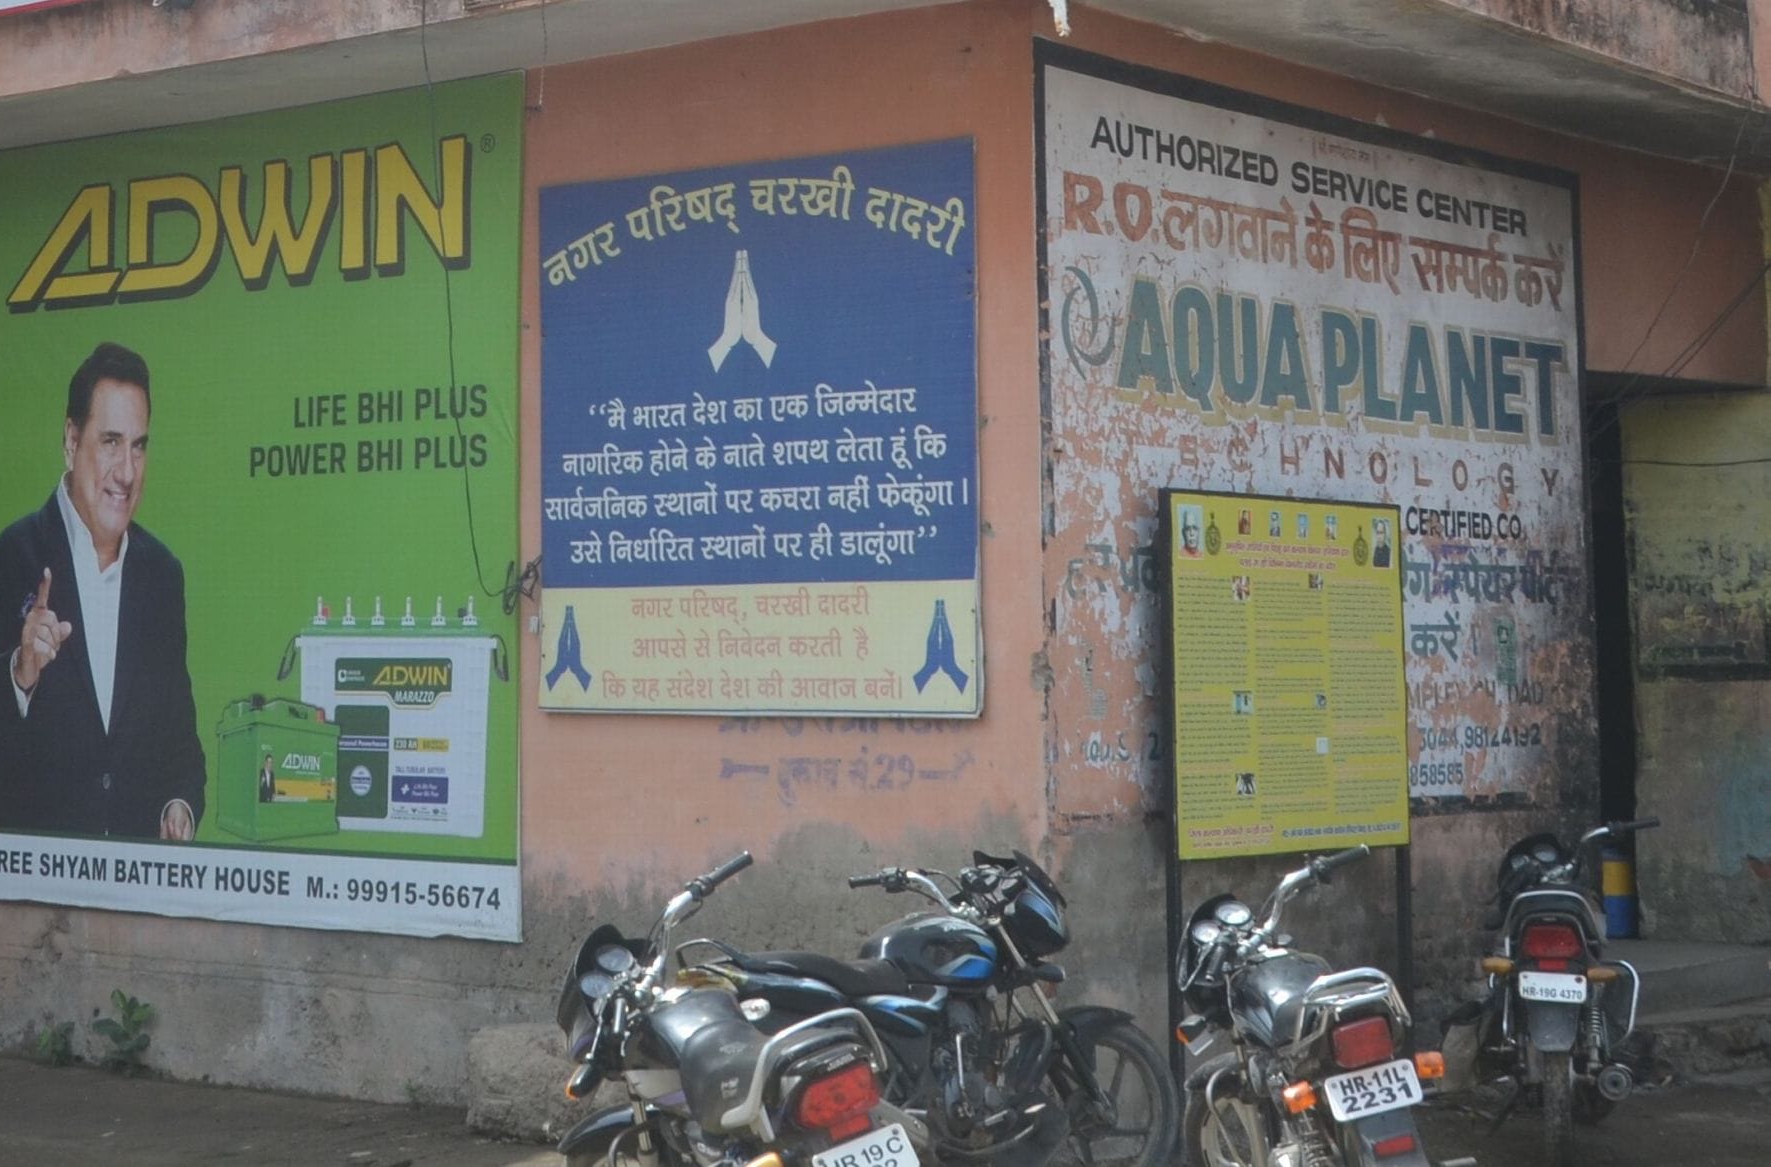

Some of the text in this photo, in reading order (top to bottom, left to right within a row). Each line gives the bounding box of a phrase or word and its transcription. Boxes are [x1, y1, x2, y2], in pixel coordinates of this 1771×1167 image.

[1091, 116, 1279, 187] AUTHORIZED
[1291, 162, 1407, 213] SERVICE
[1416, 189, 1527, 236] CENTER
[6, 134, 472, 314] ADWIN
[543, 165, 966, 287] नगर चरखी दादरी
[1117, 275, 1568, 440] AQUA PLANET
[293, 384, 488, 428] LIFE BHI PLUS
[632, 380, 917, 429] भारत देश का एक जिम्मेदार
[249, 433, 488, 478] POWER BHI PLUS
[563, 425, 947, 476] नागरिक होने के नाते शपथ लेता कि
[546, 476, 870, 522] सार्वजनिक स्थानों पर कचरा नहीं
[570, 522, 833, 564] उसे निर्धारित स्थानों पर ही
[631, 596, 673, 619] नगर
[631, 628, 711, 659] आपसे से
[372, 665, 448, 686] ADWIN
[394, 690, 435, 703] MARAZZO
[602, 670, 784, 700] कि यह देश की
[281, 753, 320, 770] ADWIN
[39, 853, 108, 882] SHYAM
[114, 858, 206, 890] BATTERY
[214, 867, 290, 897] HOUSE
[346, 879, 501, 912] 99915-56674
[1339, 1067, 1406, 1096] HR-11L
[1342, 1082, 1413, 1114] 2231
[886, 1136, 904, 1154] C
